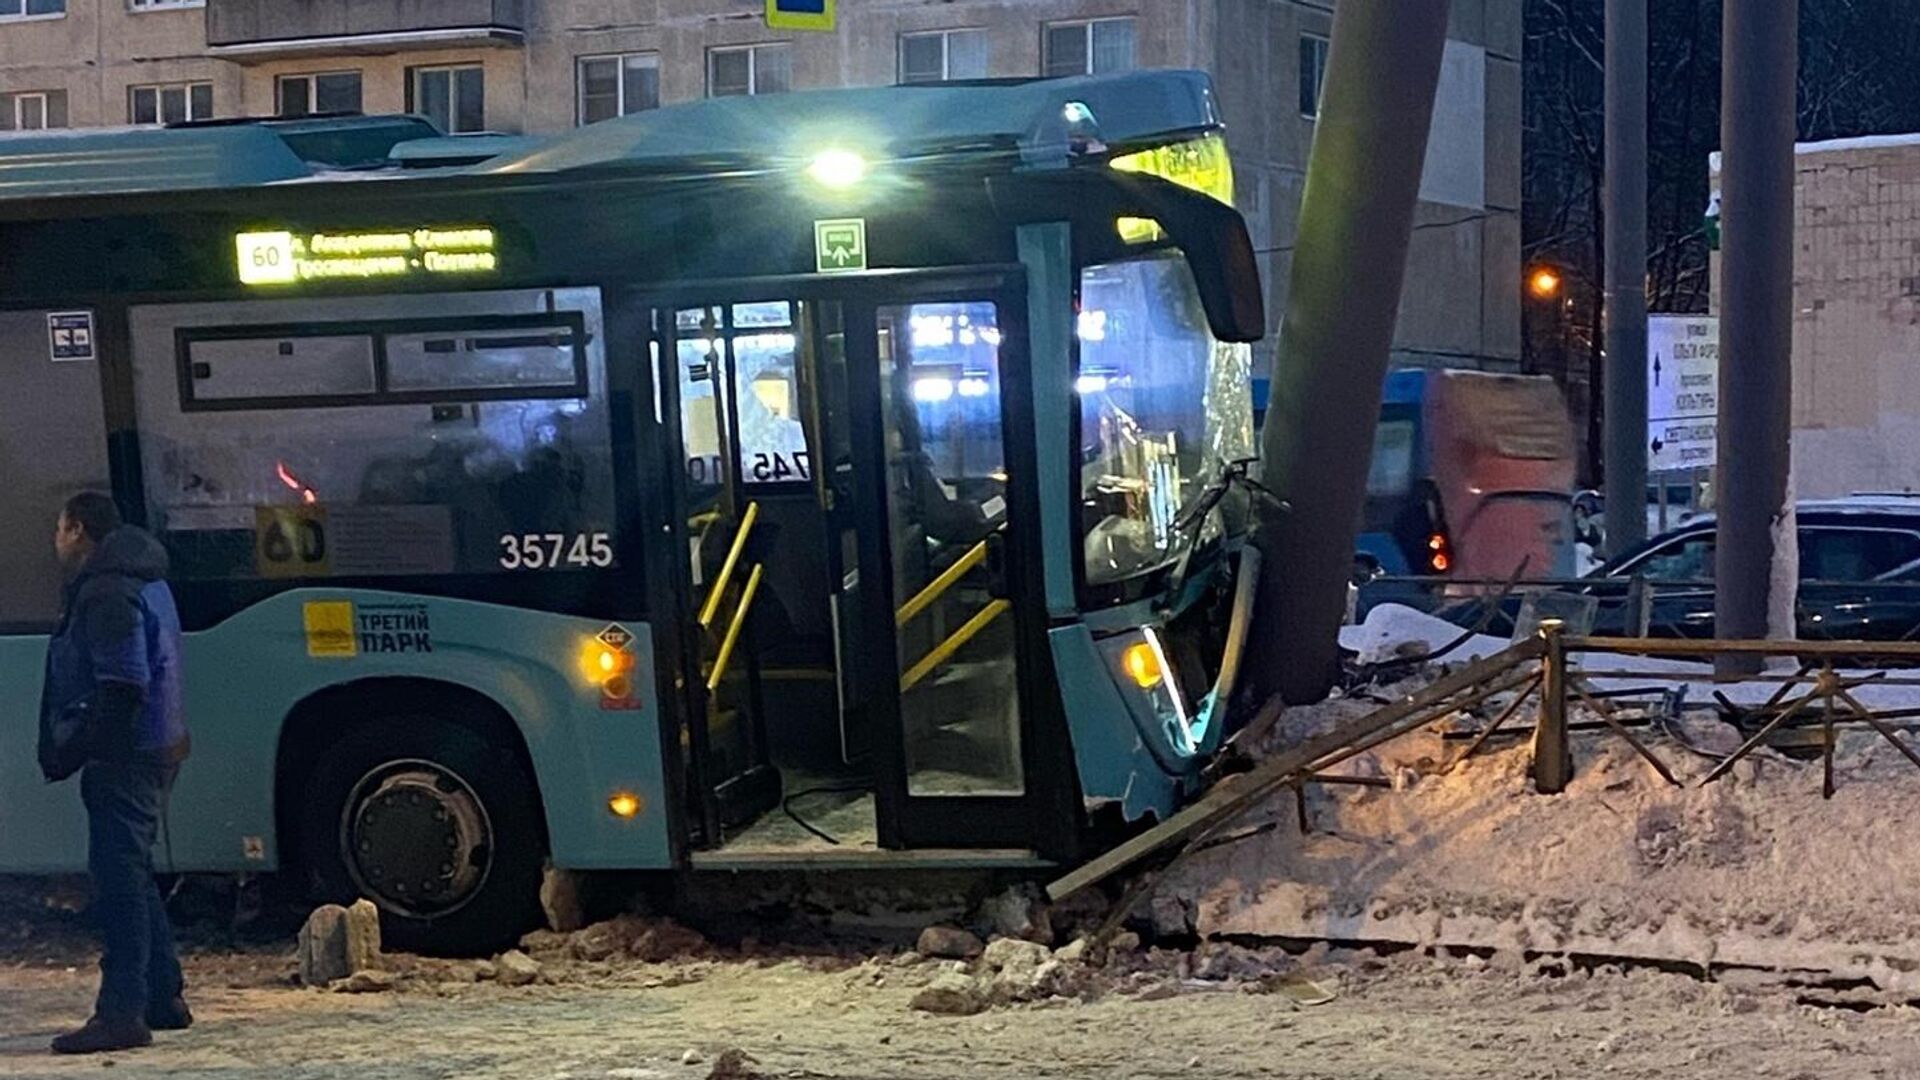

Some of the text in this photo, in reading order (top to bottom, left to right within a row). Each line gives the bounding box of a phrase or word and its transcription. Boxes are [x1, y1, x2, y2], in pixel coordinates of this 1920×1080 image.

[263, 518, 325, 562] 60
[499, 532, 613, 570] 35745
[358, 611, 430, 631] ТРЕТИЙ
[361, 632, 432, 653] ПАРК
